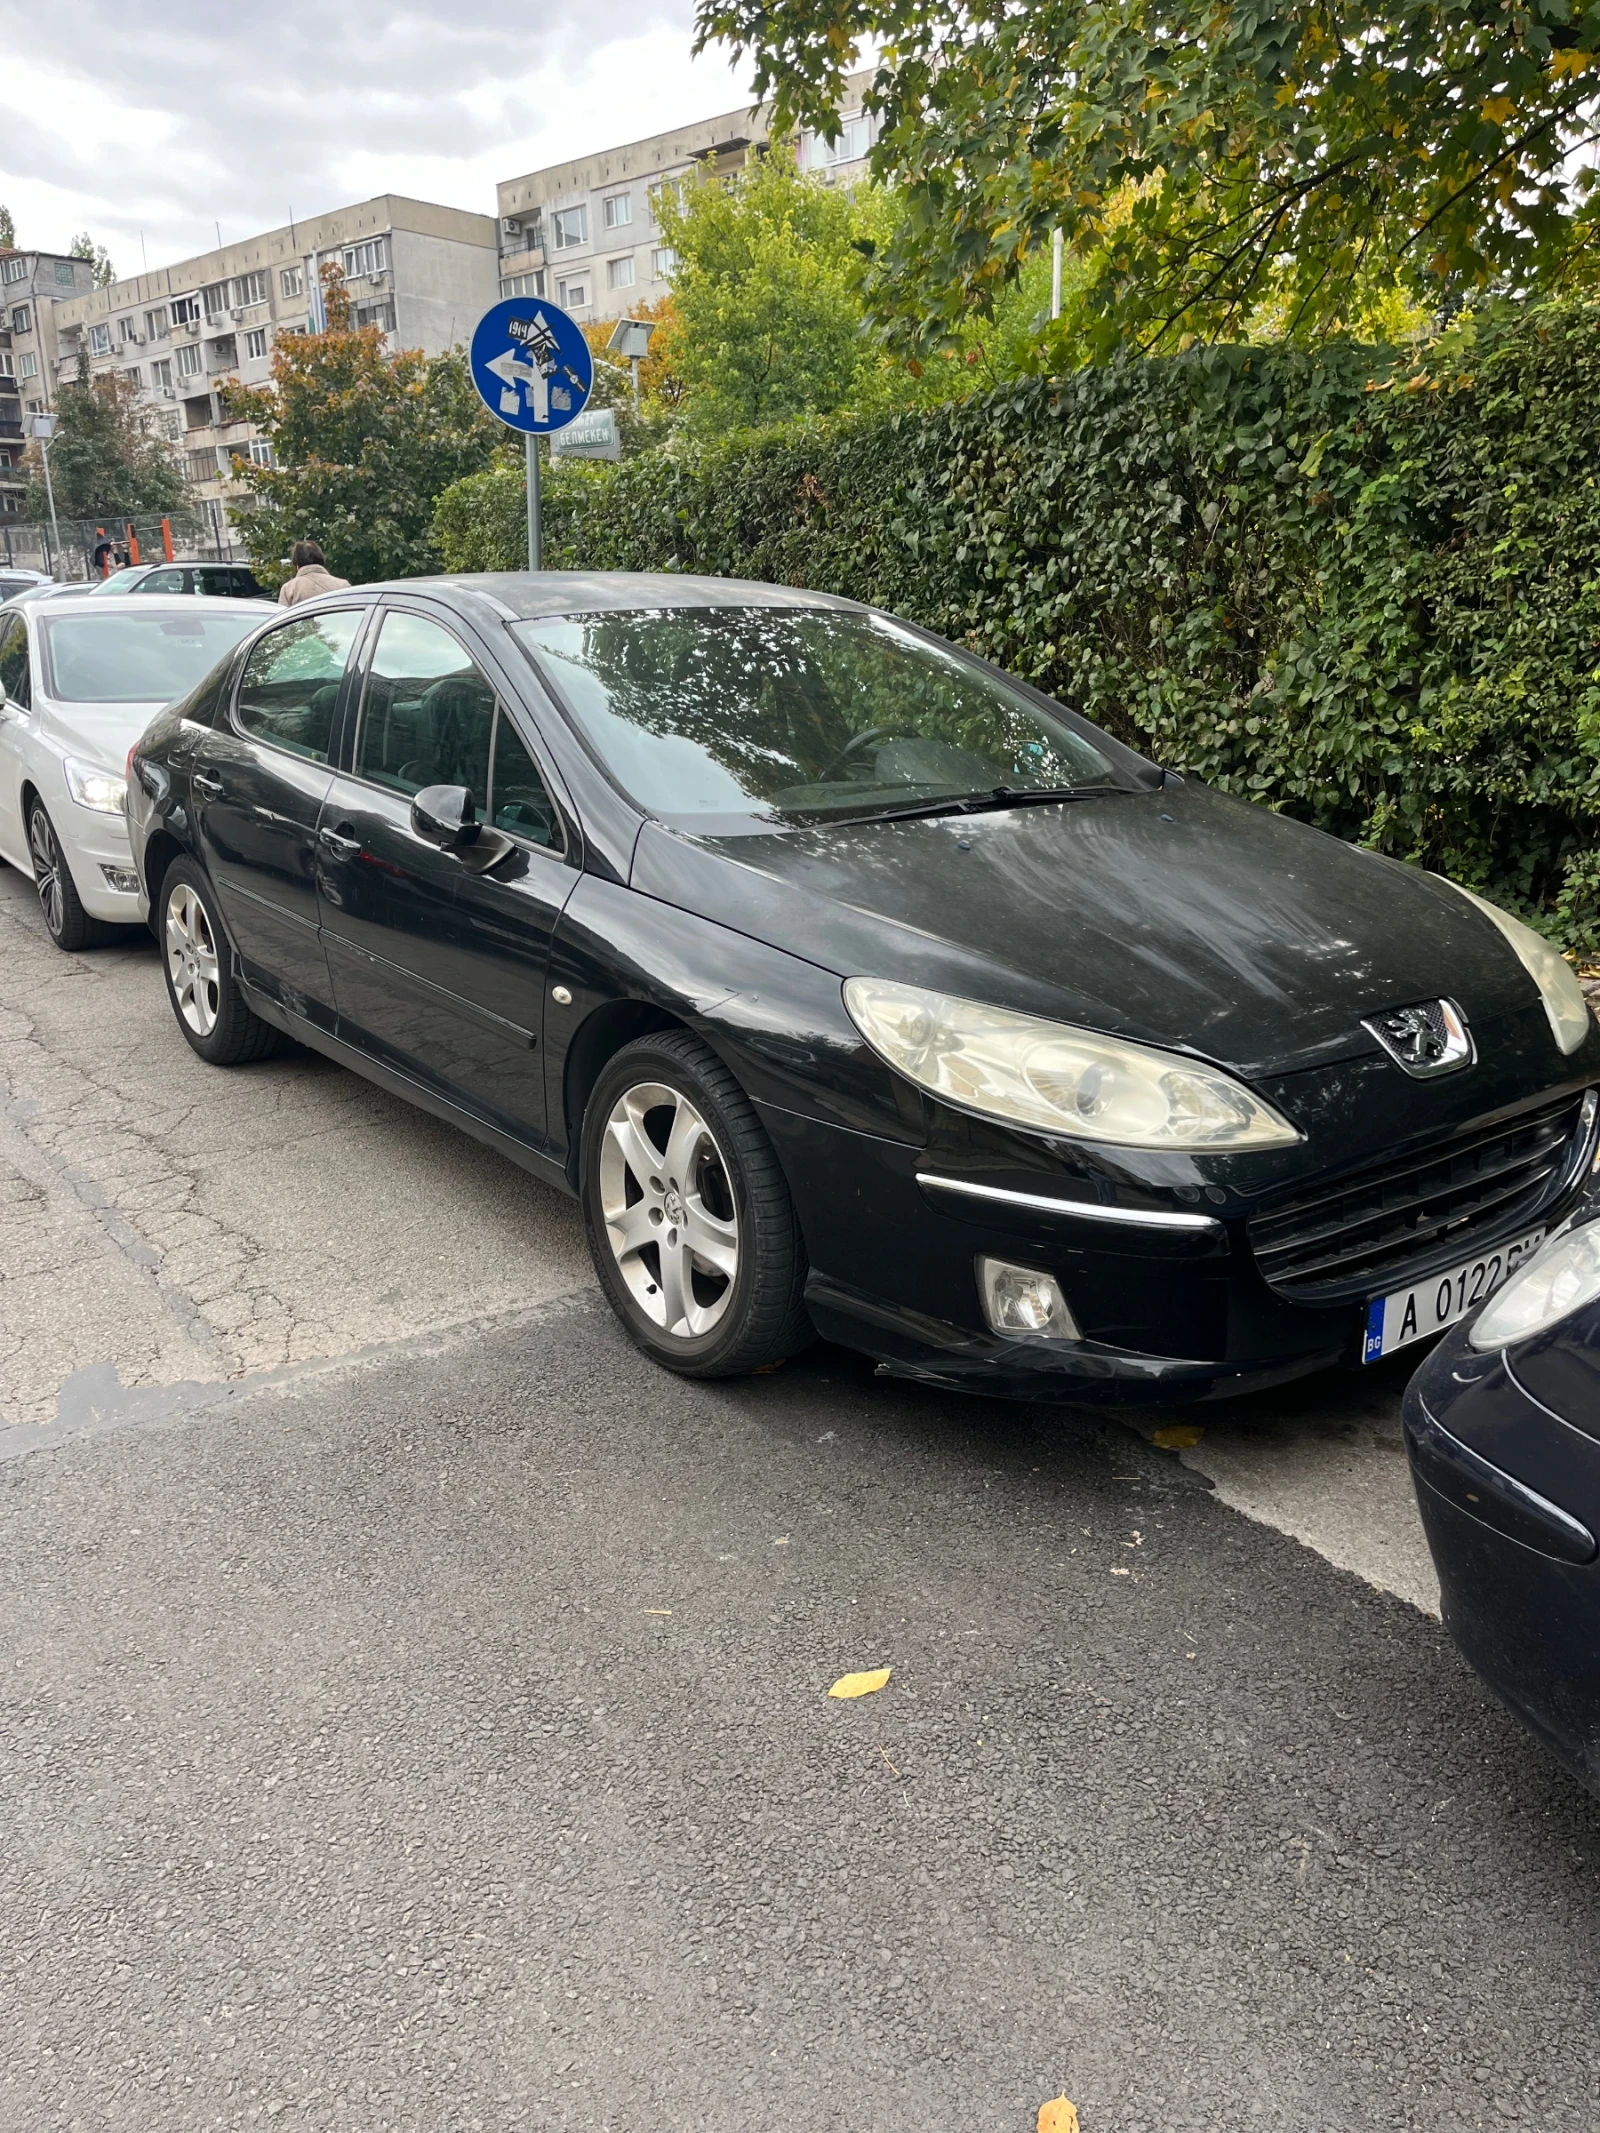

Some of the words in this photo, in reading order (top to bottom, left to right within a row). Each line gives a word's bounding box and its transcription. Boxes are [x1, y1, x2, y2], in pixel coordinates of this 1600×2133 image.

[508, 321, 528, 338] 1914
[559, 428, 609, 446] БЕЛМЕКЕН
[1398, 1292, 1418, 1341] A
[1436, 1254, 1502, 1323] 0122
[1367, 1336, 1381, 1352] BG
